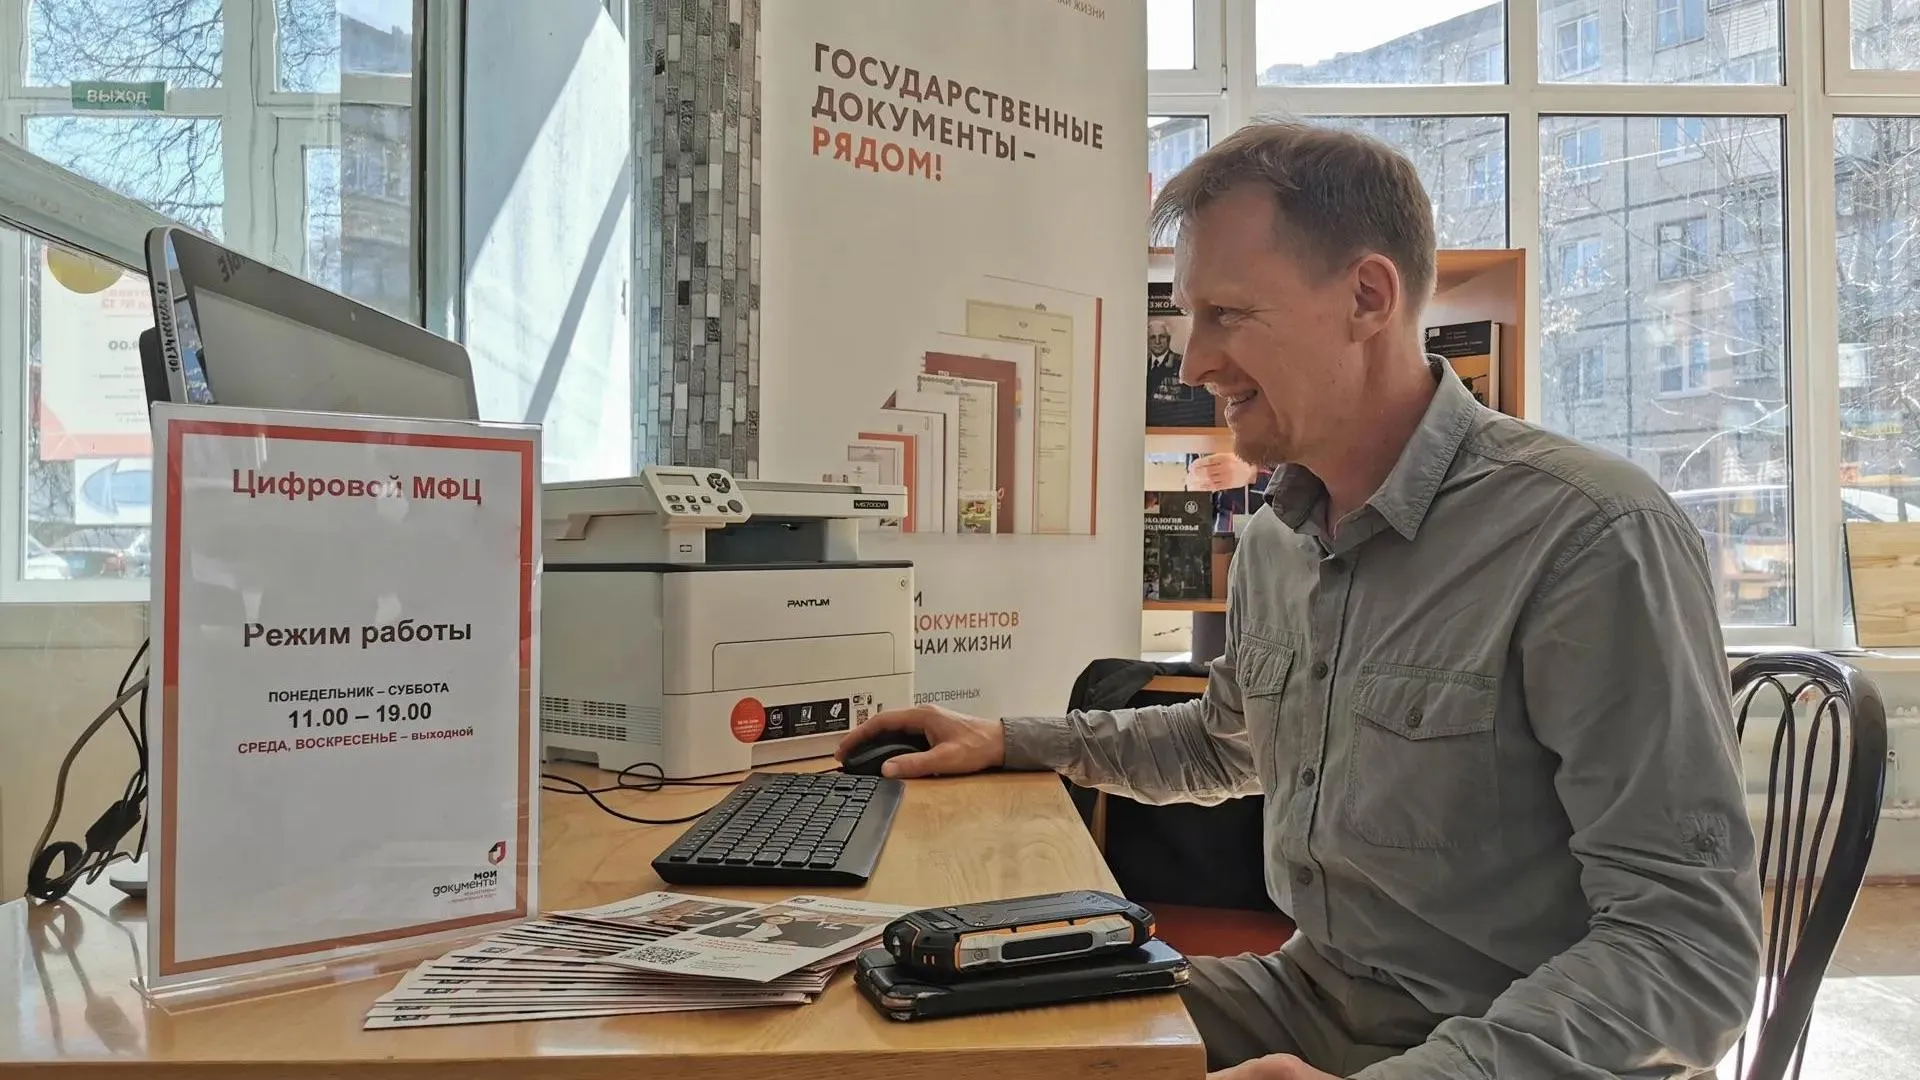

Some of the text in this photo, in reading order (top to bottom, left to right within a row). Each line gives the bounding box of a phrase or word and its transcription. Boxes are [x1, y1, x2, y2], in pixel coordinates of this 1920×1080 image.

[87, 89, 148, 106] ВЫХОД
[815, 42, 1103, 149] ГОСУДАРСТВЕННЫЕ
[812, 85, 1015, 161] ДОКУМЕНТЫ
[813, 126, 942, 181] РЯДОМ!
[233, 469, 481, 505] Цифровой МФЦ
[787, 598, 830, 608] PANTUM
[244, 619, 471, 649] Режим работы
[914, 634, 1012, 655] ЧАИ ЖИЗНИ
[268, 687, 374, 703] ПОНЕДЕЛЬНИК
[388, 682, 449, 697] СУББОТА
[914, 688, 981, 706] дарственных
[289, 707, 348, 728] 11.00
[376, 702, 432, 723] 19.00
[238, 740, 291, 754] СРЕДА,
[296, 732, 397, 750] ВОСКРЕСЕНЬЕ
[411, 725, 473, 741] выходной
[474, 870, 498, 880] мои
[433, 878, 497, 897] документы
